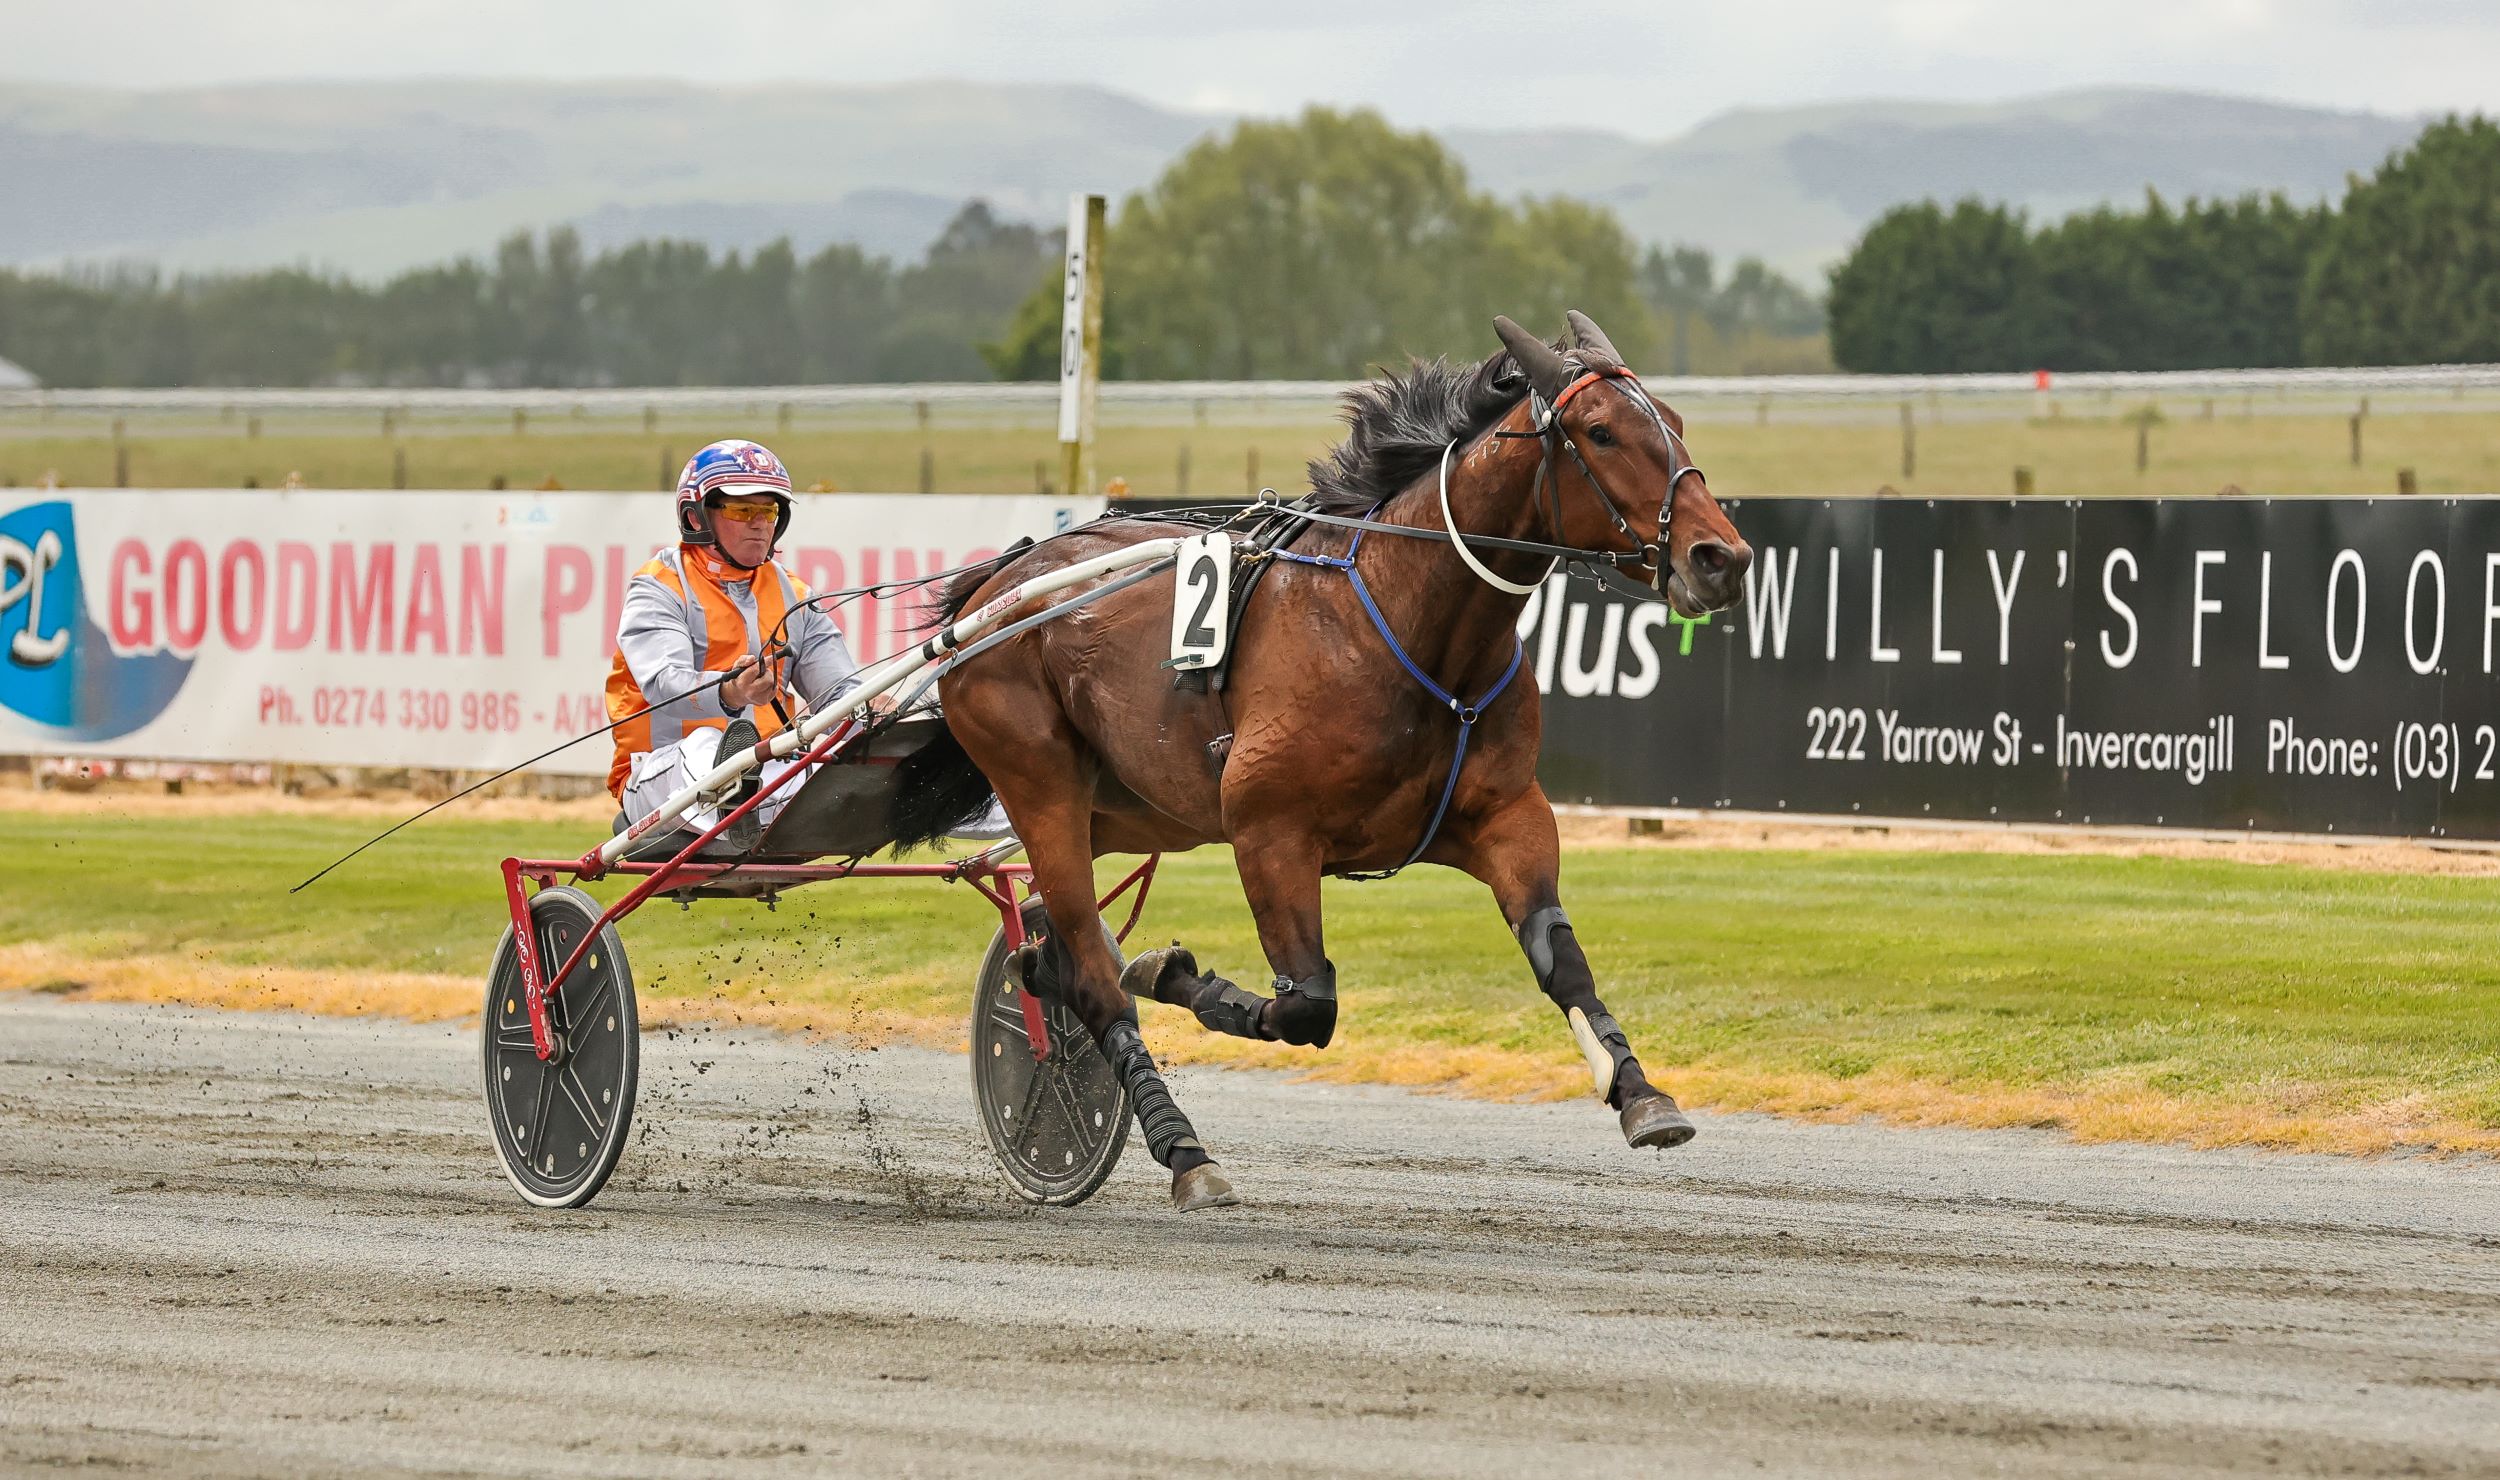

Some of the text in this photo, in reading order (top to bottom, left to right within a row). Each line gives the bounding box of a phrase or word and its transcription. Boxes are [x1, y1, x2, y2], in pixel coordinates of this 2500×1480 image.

[109, 536, 505, 658] GOODMAN
[1183, 554, 1218, 647] 2
[1744, 546, 2139, 669] WILLY'S
[258, 686, 302, 726] Ph.
[313, 687, 386, 727] 0274
[399, 689, 449, 731] 330
[461, 691, 520, 732] 986
[1806, 706, 1867, 760] 222
[1875, 708, 1984, 765] Yarrow
[1992, 711, 2022, 766] St
[2056, 714, 2234, 785] Invercargill
[2267, 717, 2379, 776] Phone:
[2393, 720, 2460, 794] (03)
[2475, 724, 2496, 780] 2
